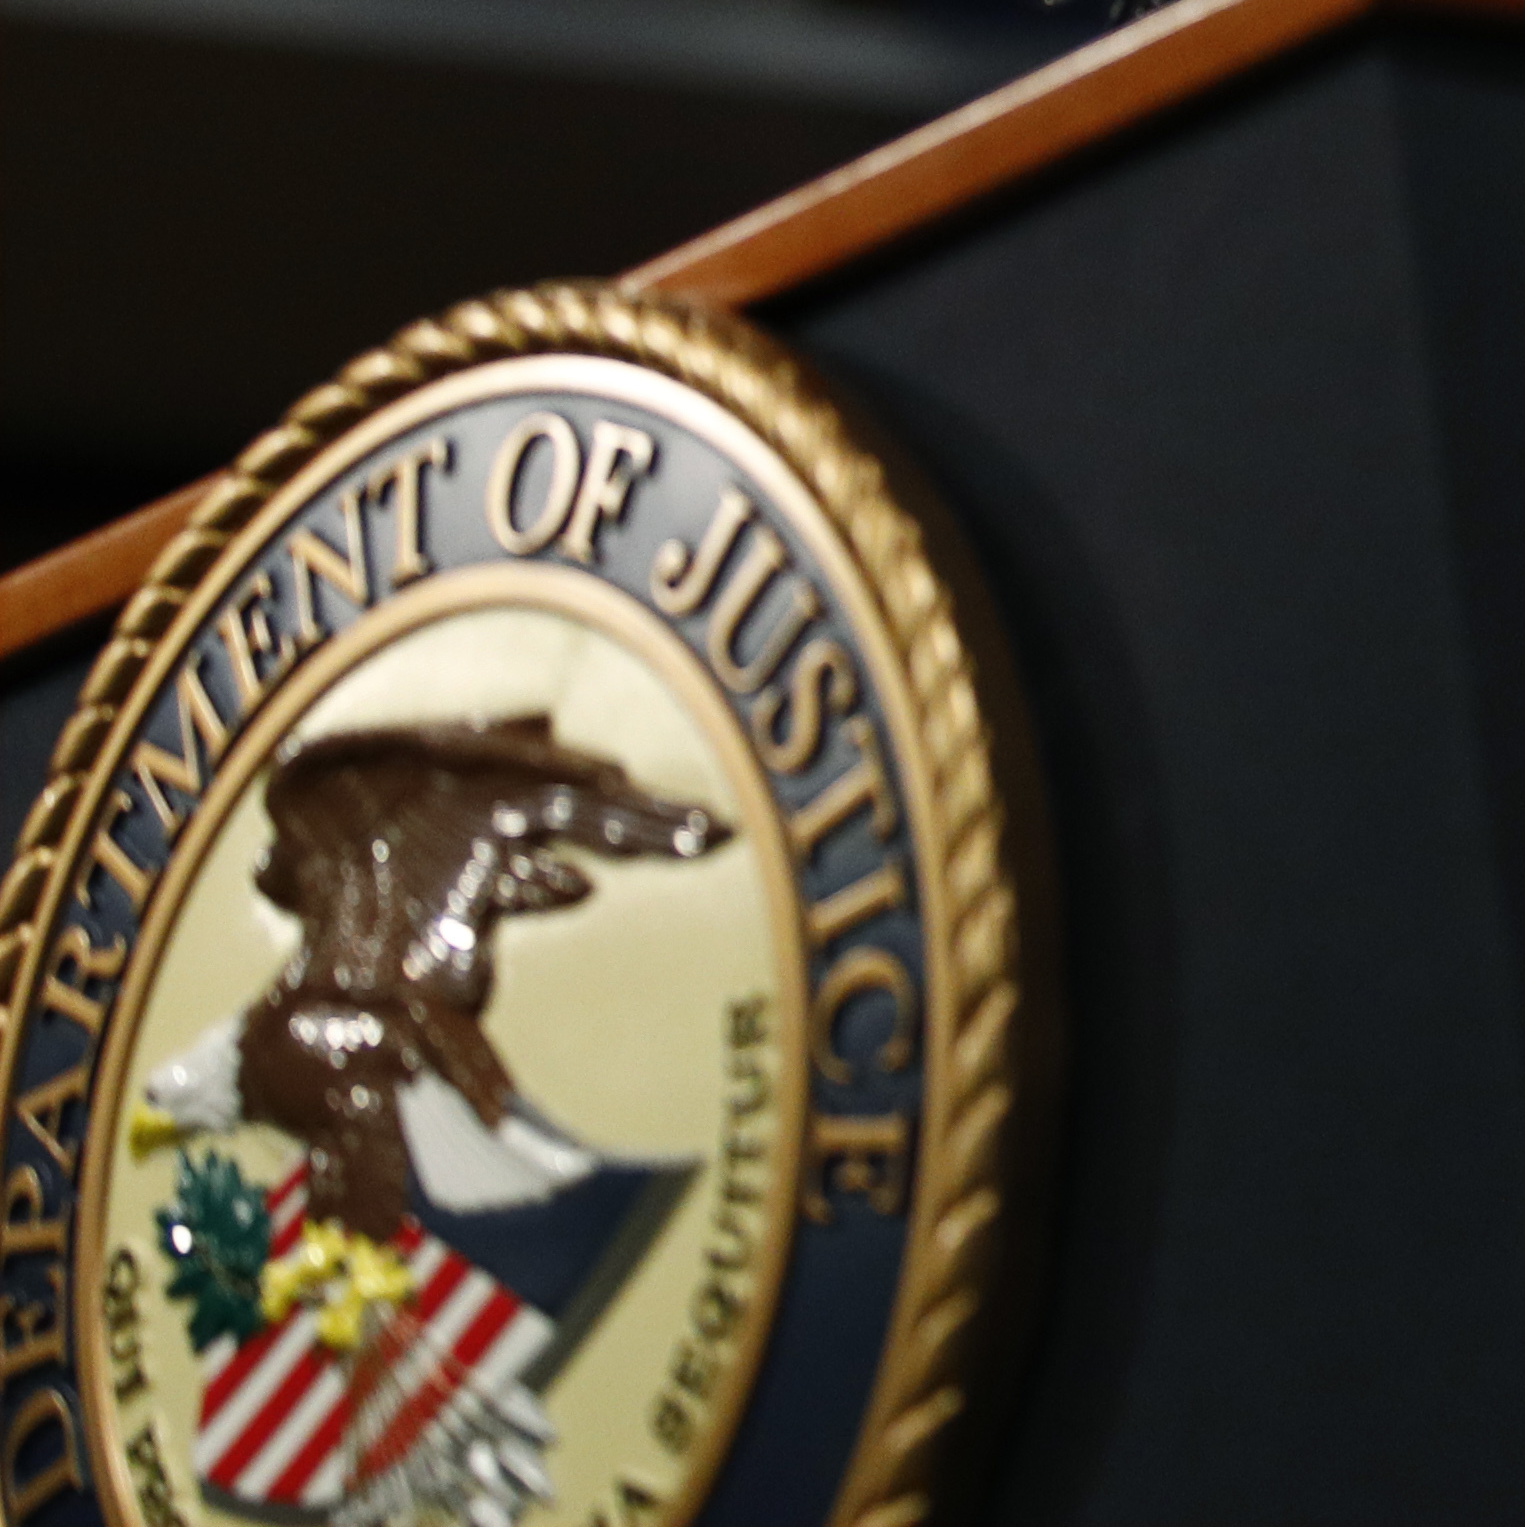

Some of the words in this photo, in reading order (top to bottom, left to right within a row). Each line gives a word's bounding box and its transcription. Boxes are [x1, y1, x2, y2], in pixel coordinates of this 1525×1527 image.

[0, 436, 451, 1521] DEPARTMENT
[485, 412, 655, 564] OF
[650, 483, 917, 1225] JUSTICE
[650, 991, 771, 1454] SEQUITUR
